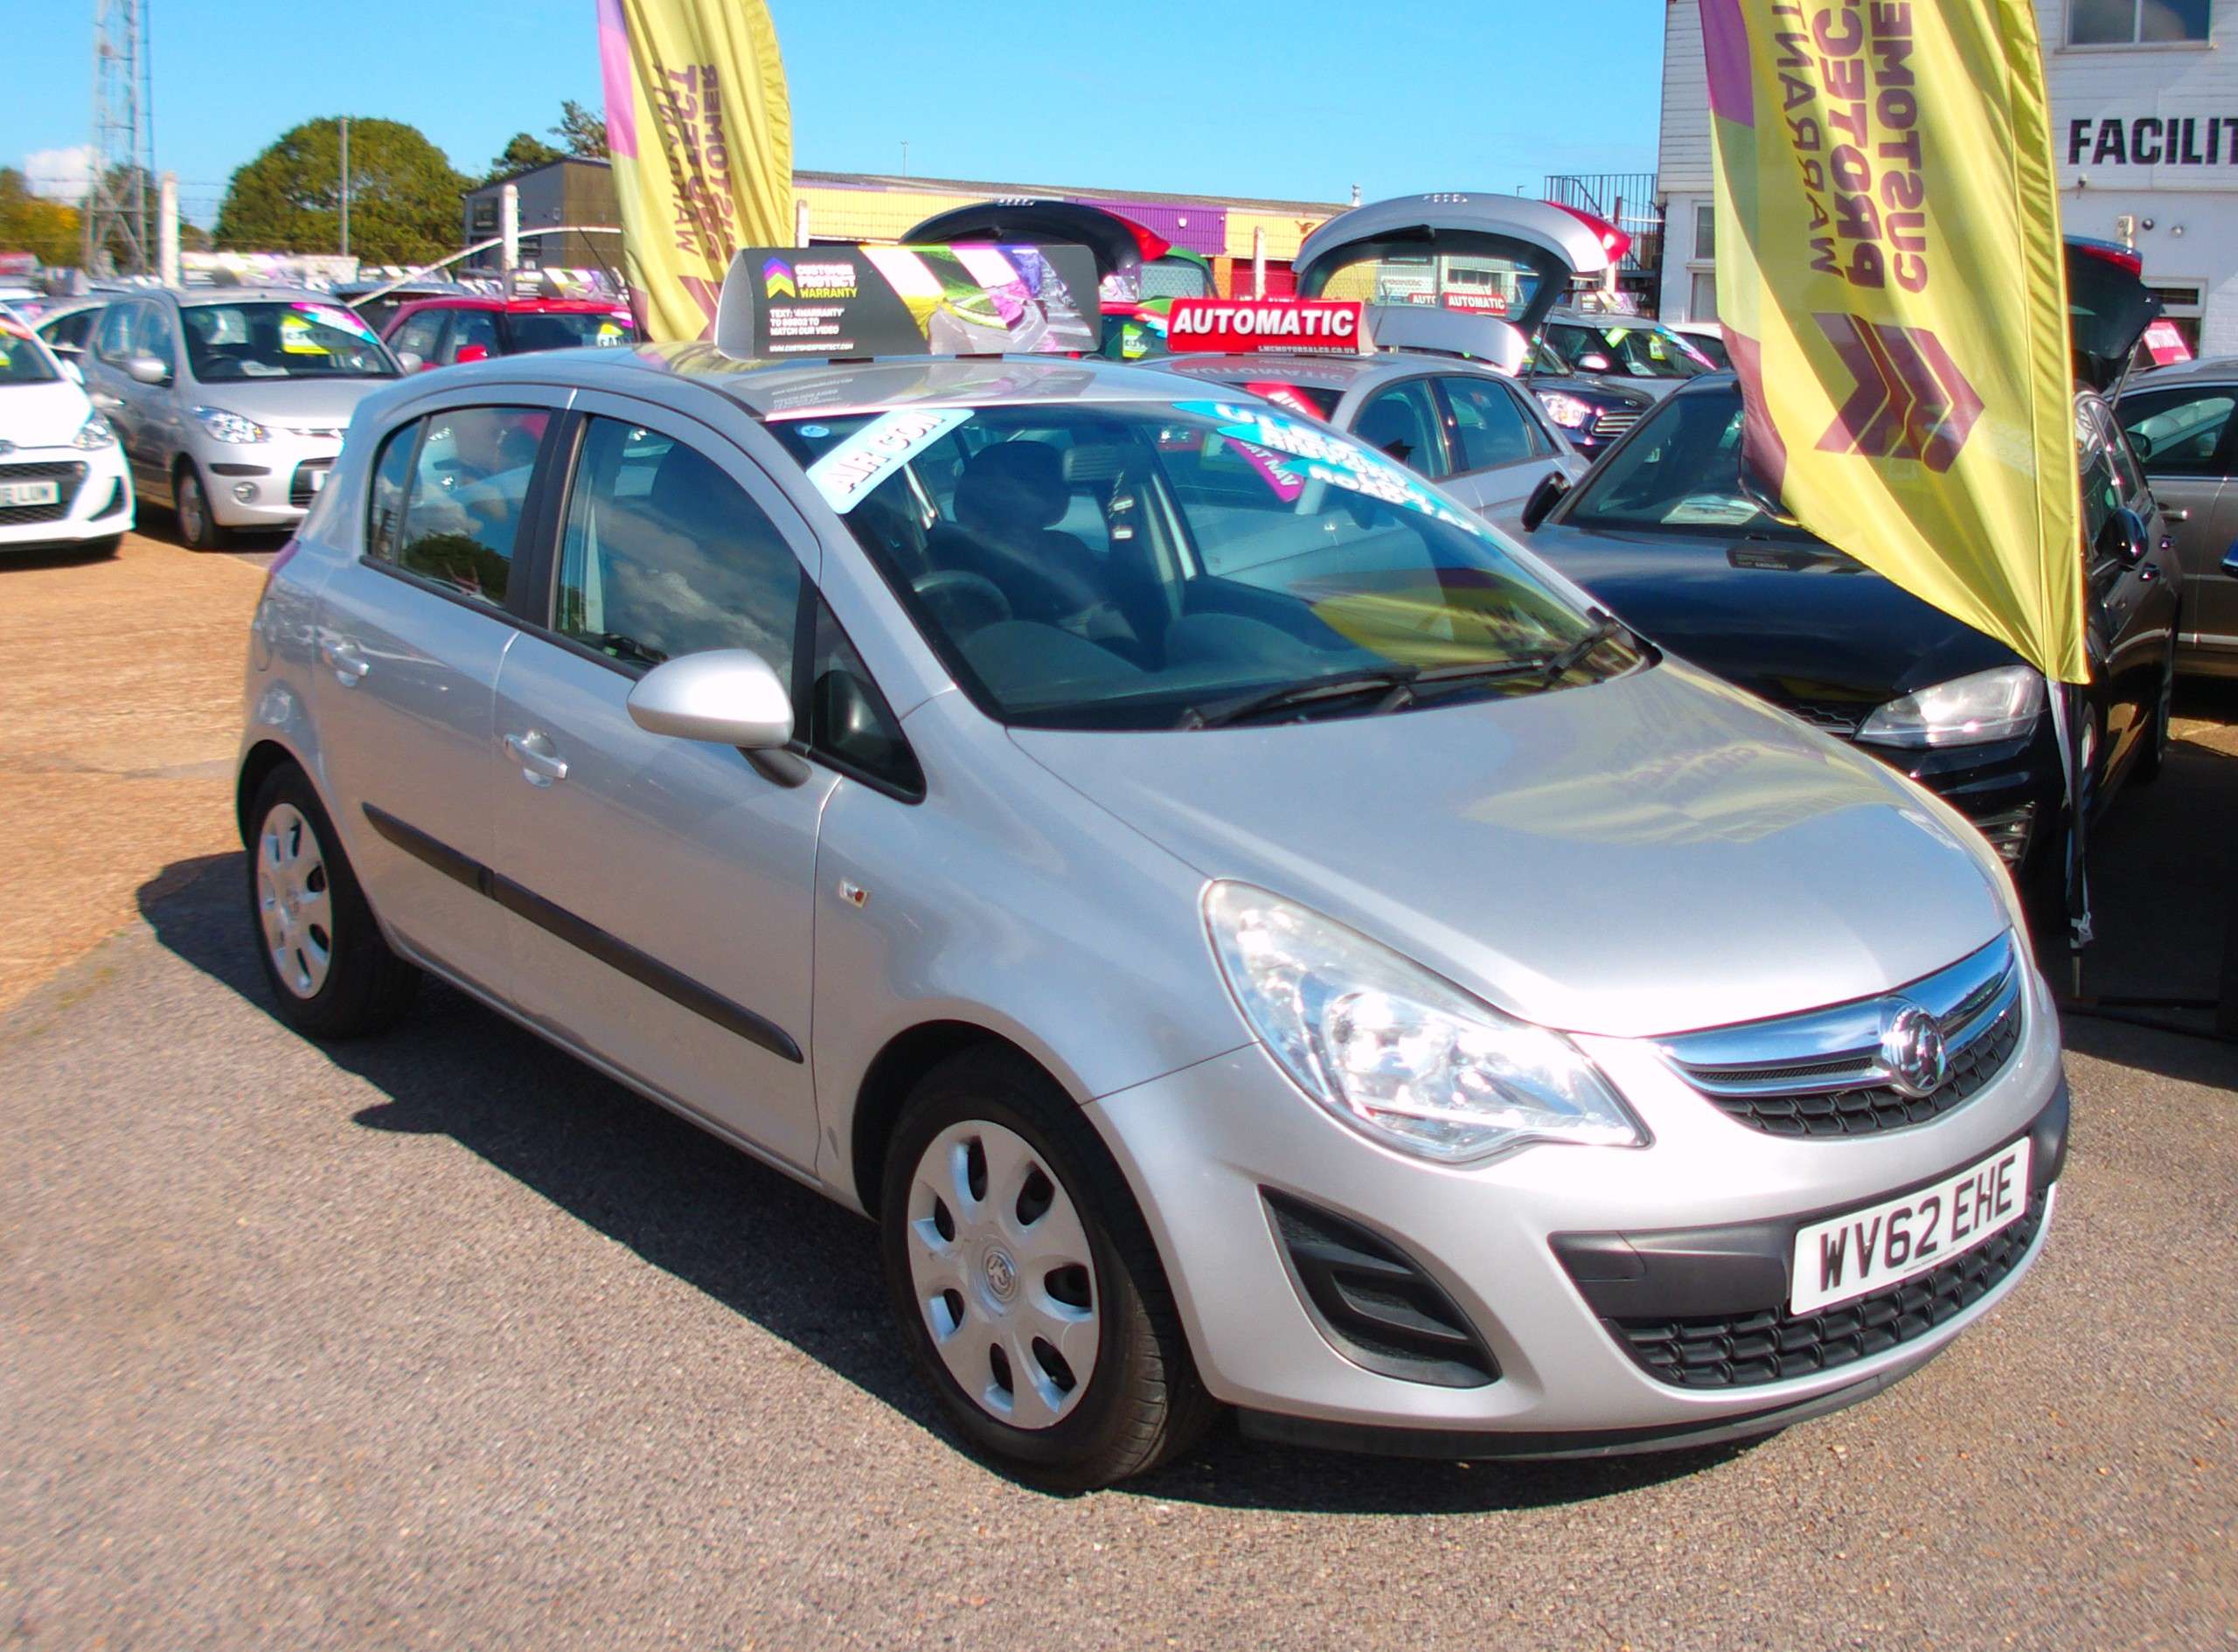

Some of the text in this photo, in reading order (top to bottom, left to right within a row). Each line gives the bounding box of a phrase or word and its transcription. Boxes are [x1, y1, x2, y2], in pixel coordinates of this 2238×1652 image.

[796, 275, 856, 288] PROTECT
[800, 288, 858, 298] WARRANTY
[1448, 295, 1505, 309] AUTOMATIC
[1172, 308, 1354, 337] AUTOMATIC
[1265, 460, 1299, 486] NAV
[1820, 1154, 2016, 1293] WV62 EHE
